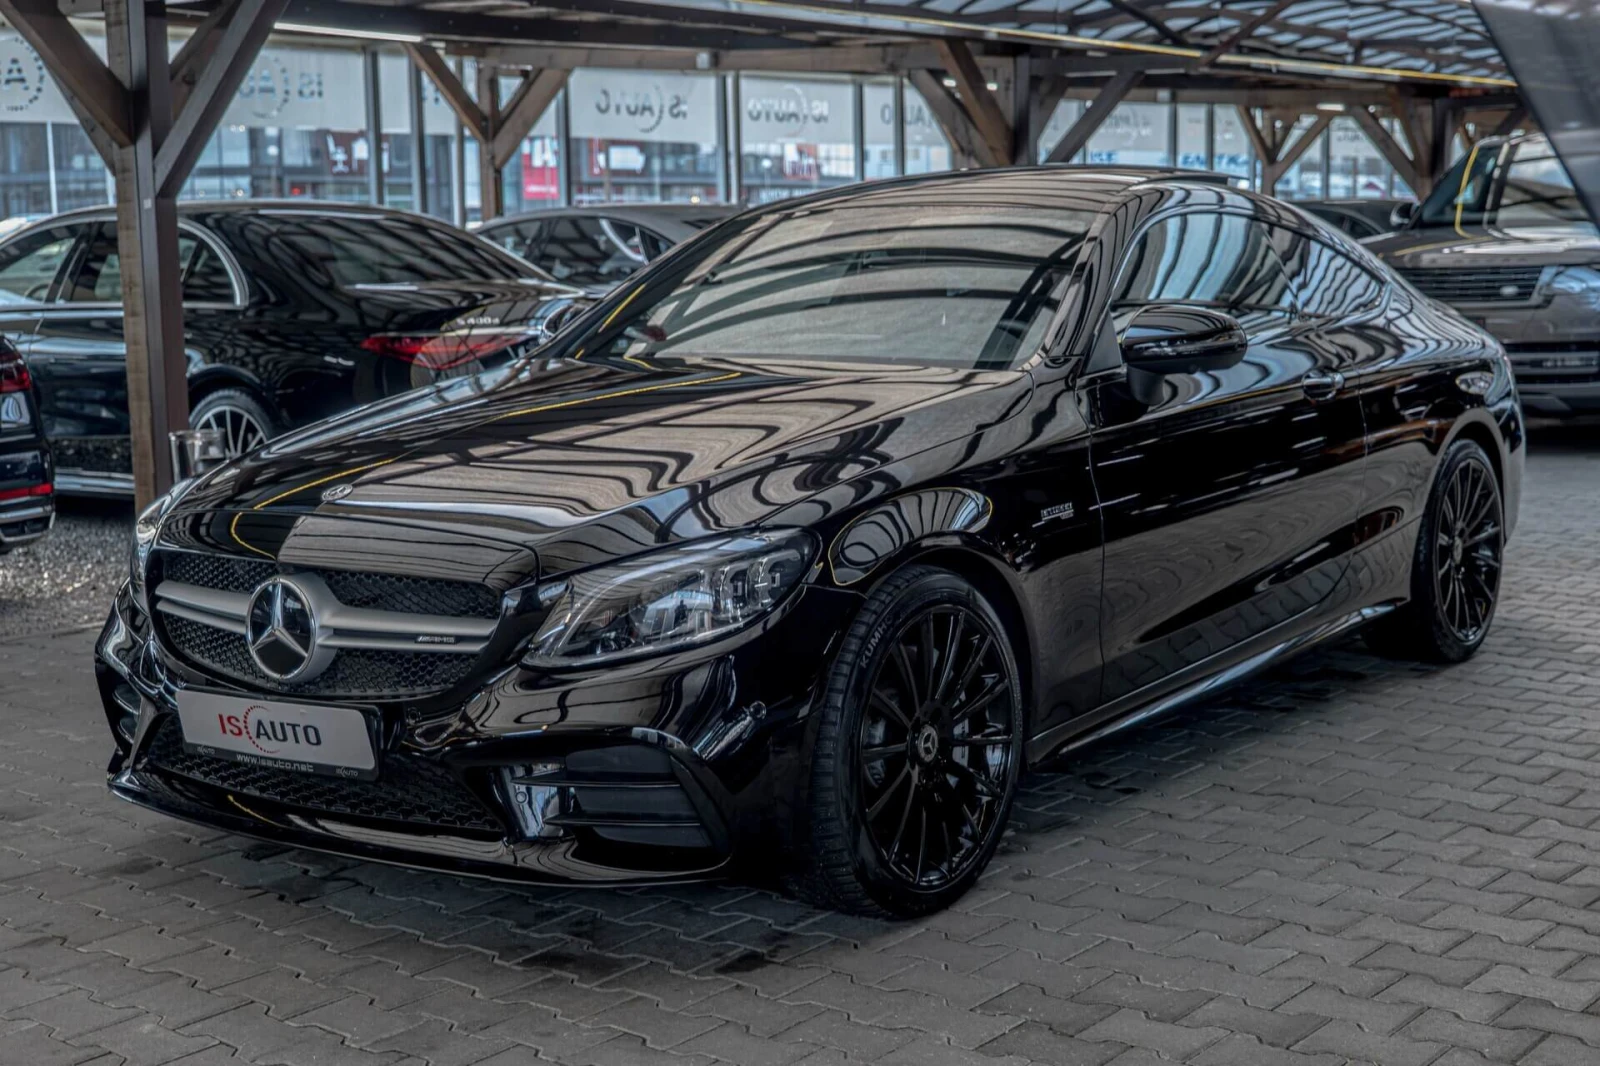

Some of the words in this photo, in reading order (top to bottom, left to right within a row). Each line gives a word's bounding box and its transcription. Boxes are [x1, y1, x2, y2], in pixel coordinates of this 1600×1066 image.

[860, 614, 894, 668] KUMHO
[218, 713, 243, 737] IS
[255, 719, 322, 746] AUTO
[236, 753, 314, 772] www.isauto.net
